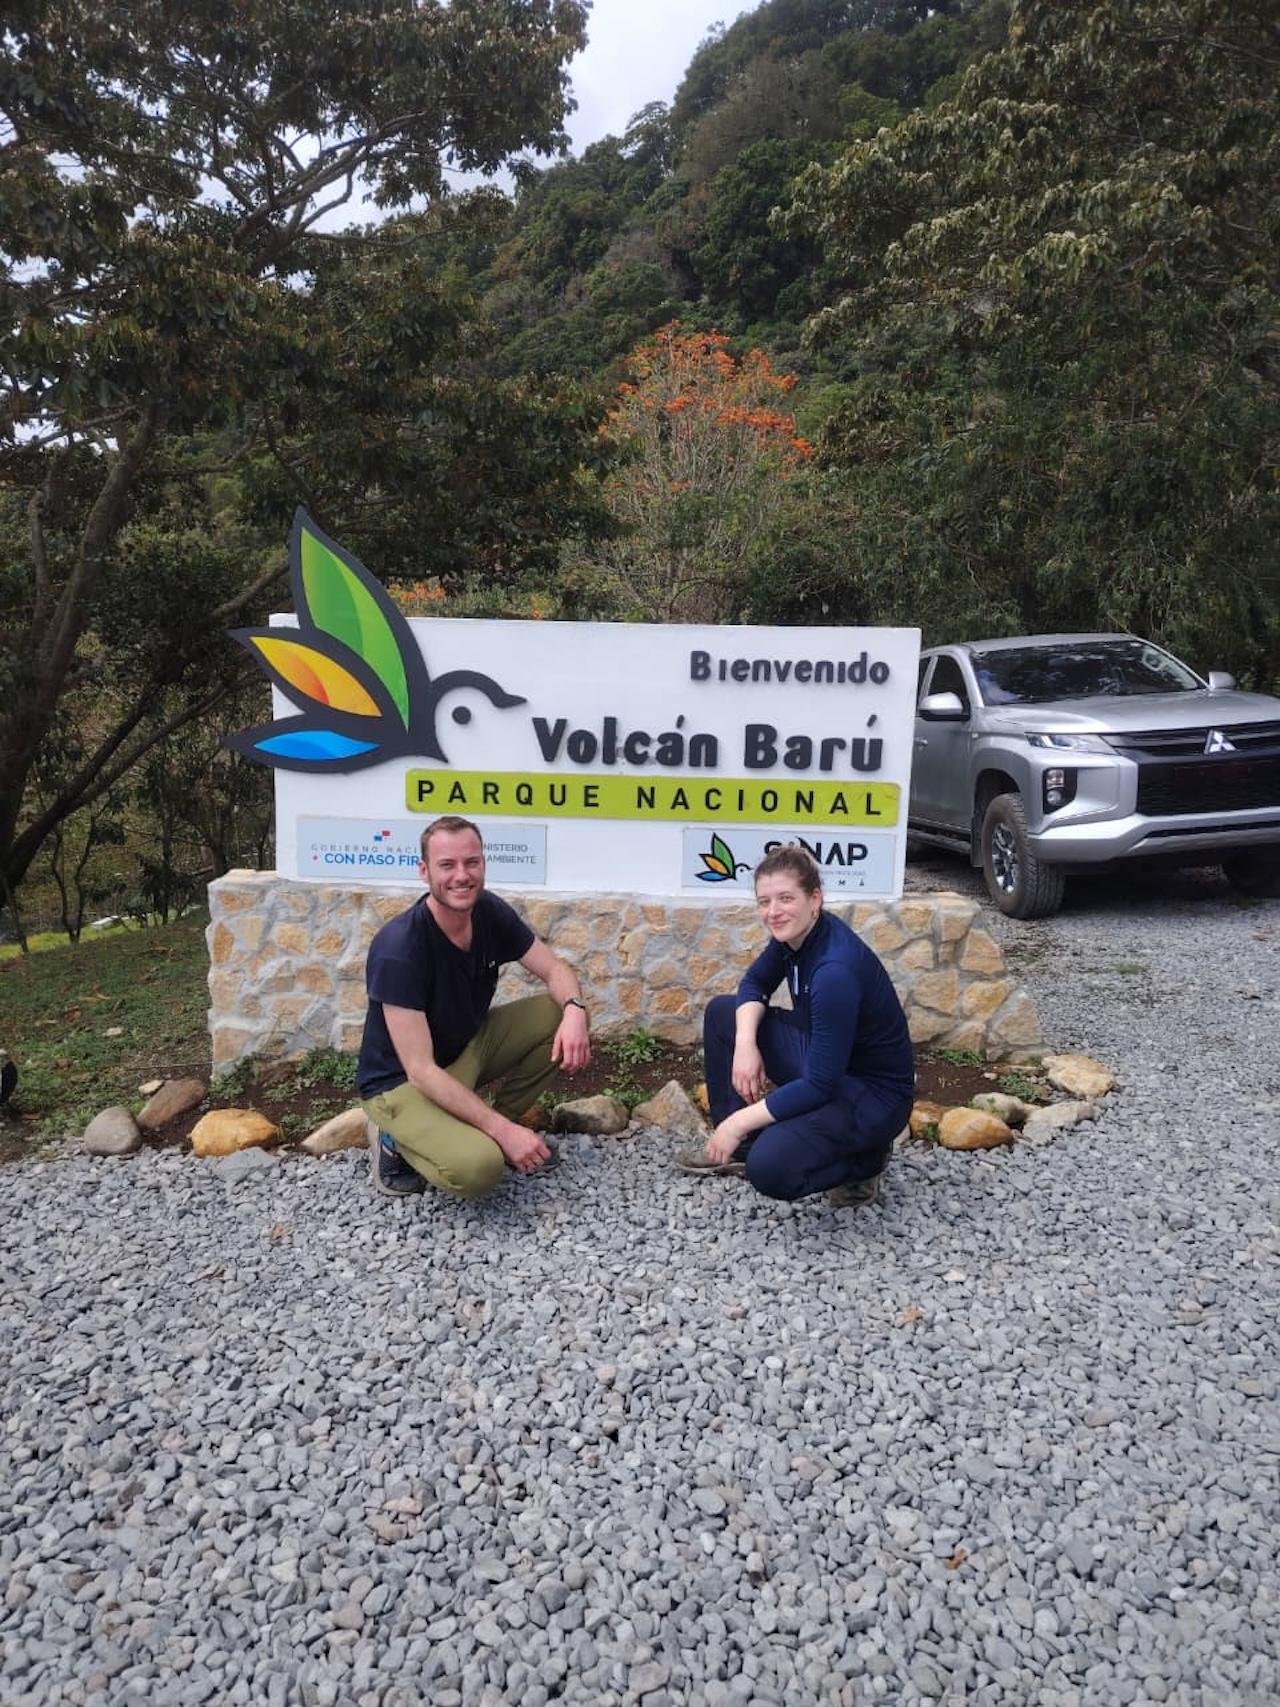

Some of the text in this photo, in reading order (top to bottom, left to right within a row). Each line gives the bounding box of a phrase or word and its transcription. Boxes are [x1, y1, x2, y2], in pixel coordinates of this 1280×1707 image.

[690, 650, 889, 684] Bienvenido
[534, 715, 883, 771] Volcán Barú
[418, 780, 881, 815] PARQUE NACIONAL
[311, 843, 419, 854] GOBIERNO NACI
[484, 843, 528, 853] NISTERIO
[764, 836, 868, 866] SNAP
[324, 853, 420, 866] CON PASO FIR
[487, 855, 537, 864] AMBIENTE
